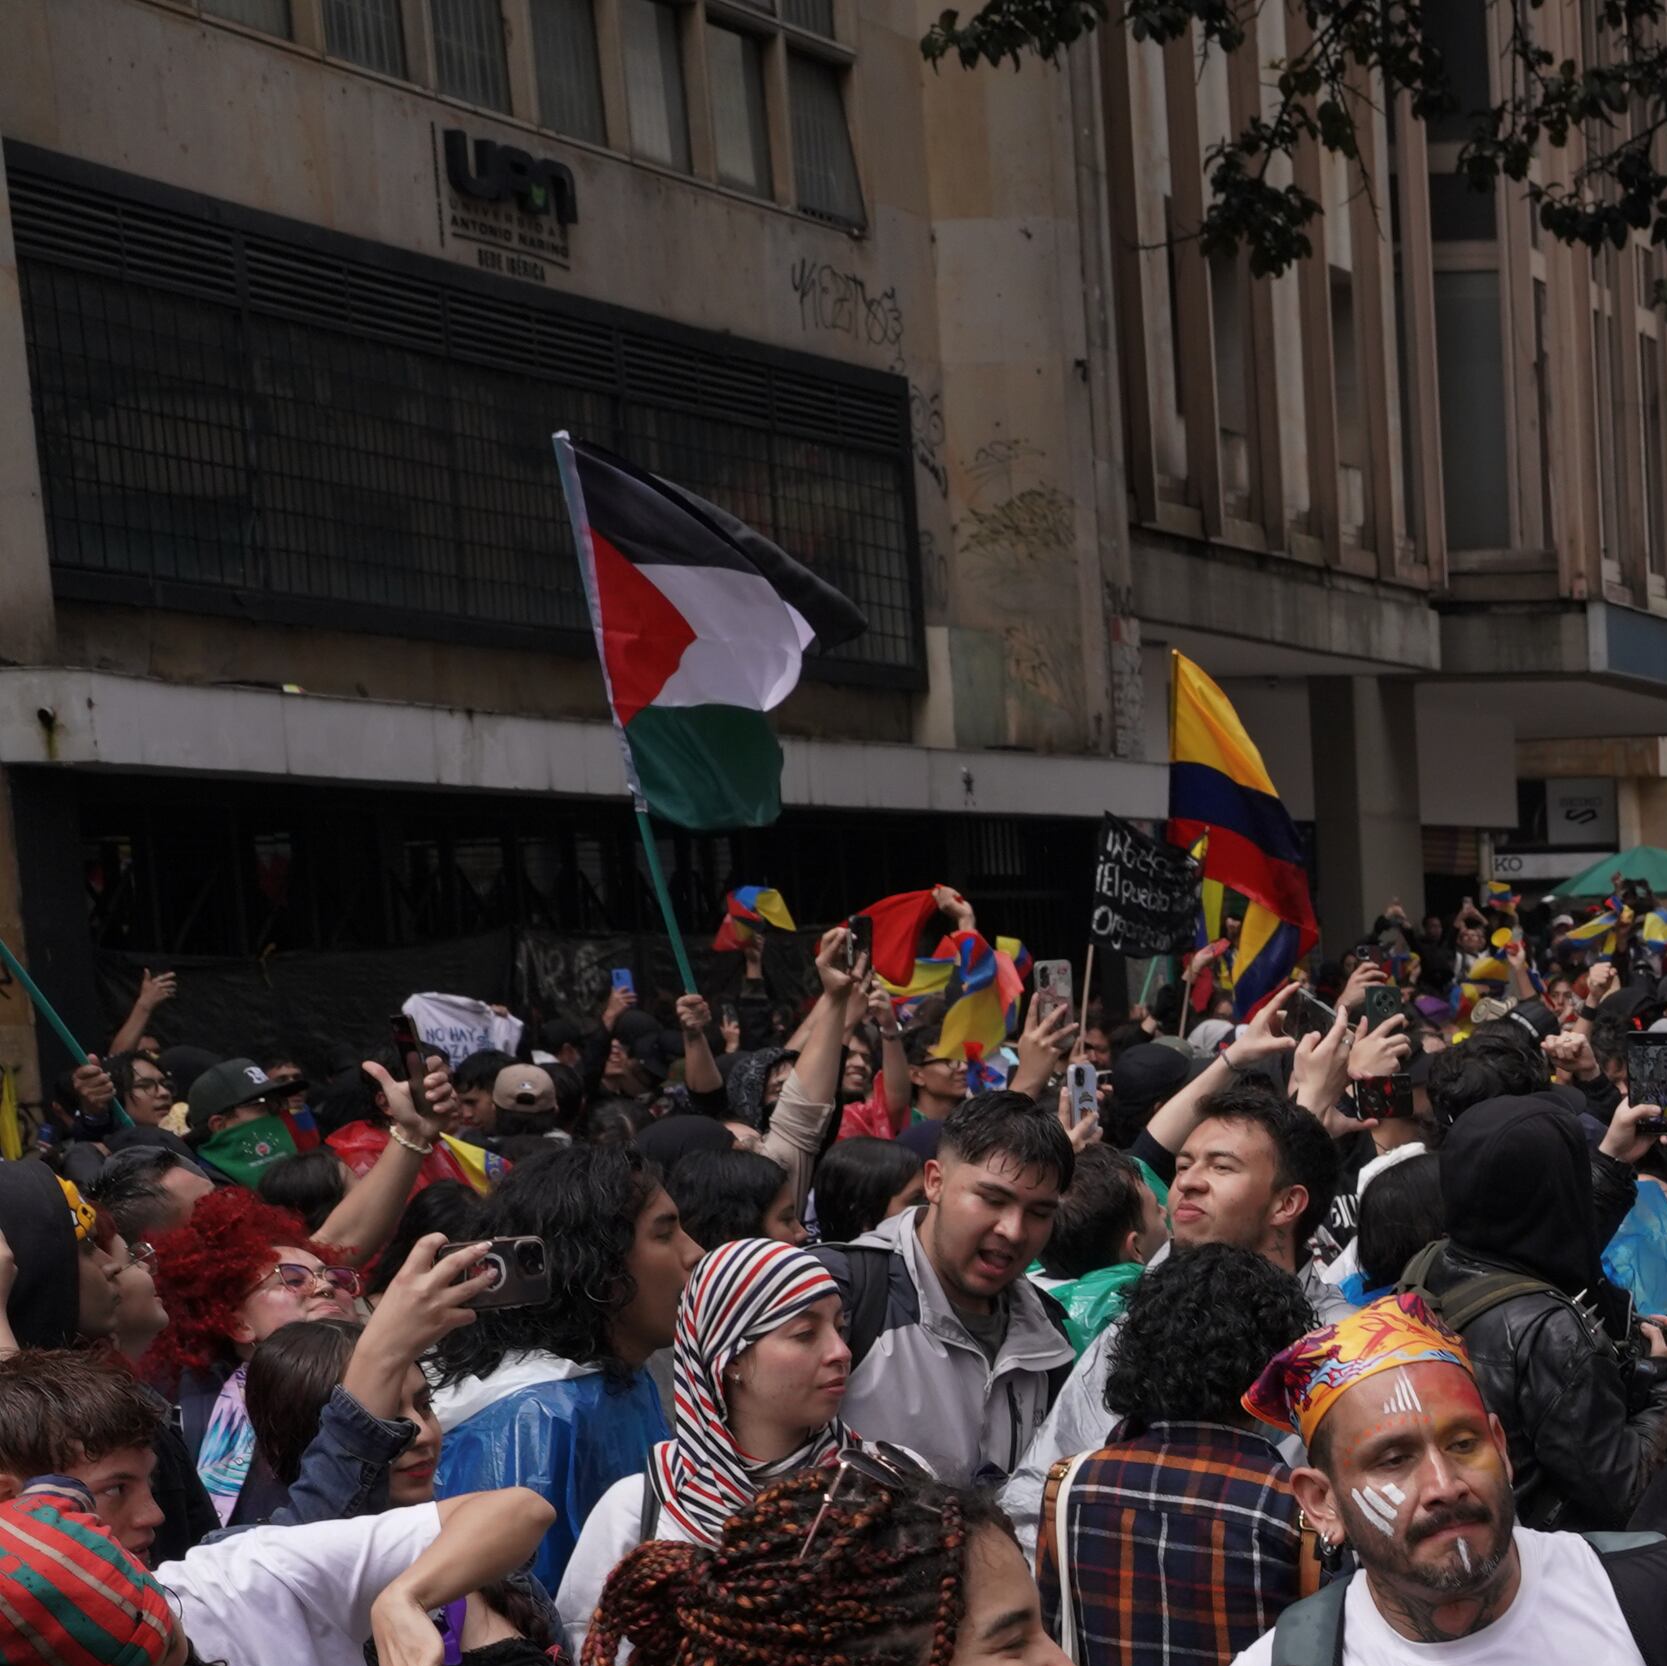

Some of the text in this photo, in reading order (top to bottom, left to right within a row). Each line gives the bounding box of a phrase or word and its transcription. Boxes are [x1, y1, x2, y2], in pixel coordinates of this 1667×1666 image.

[451, 215, 512, 241] ANTONIO
[425, 1027, 445, 1042] NO
[449, 1026, 477, 1042] HAY
